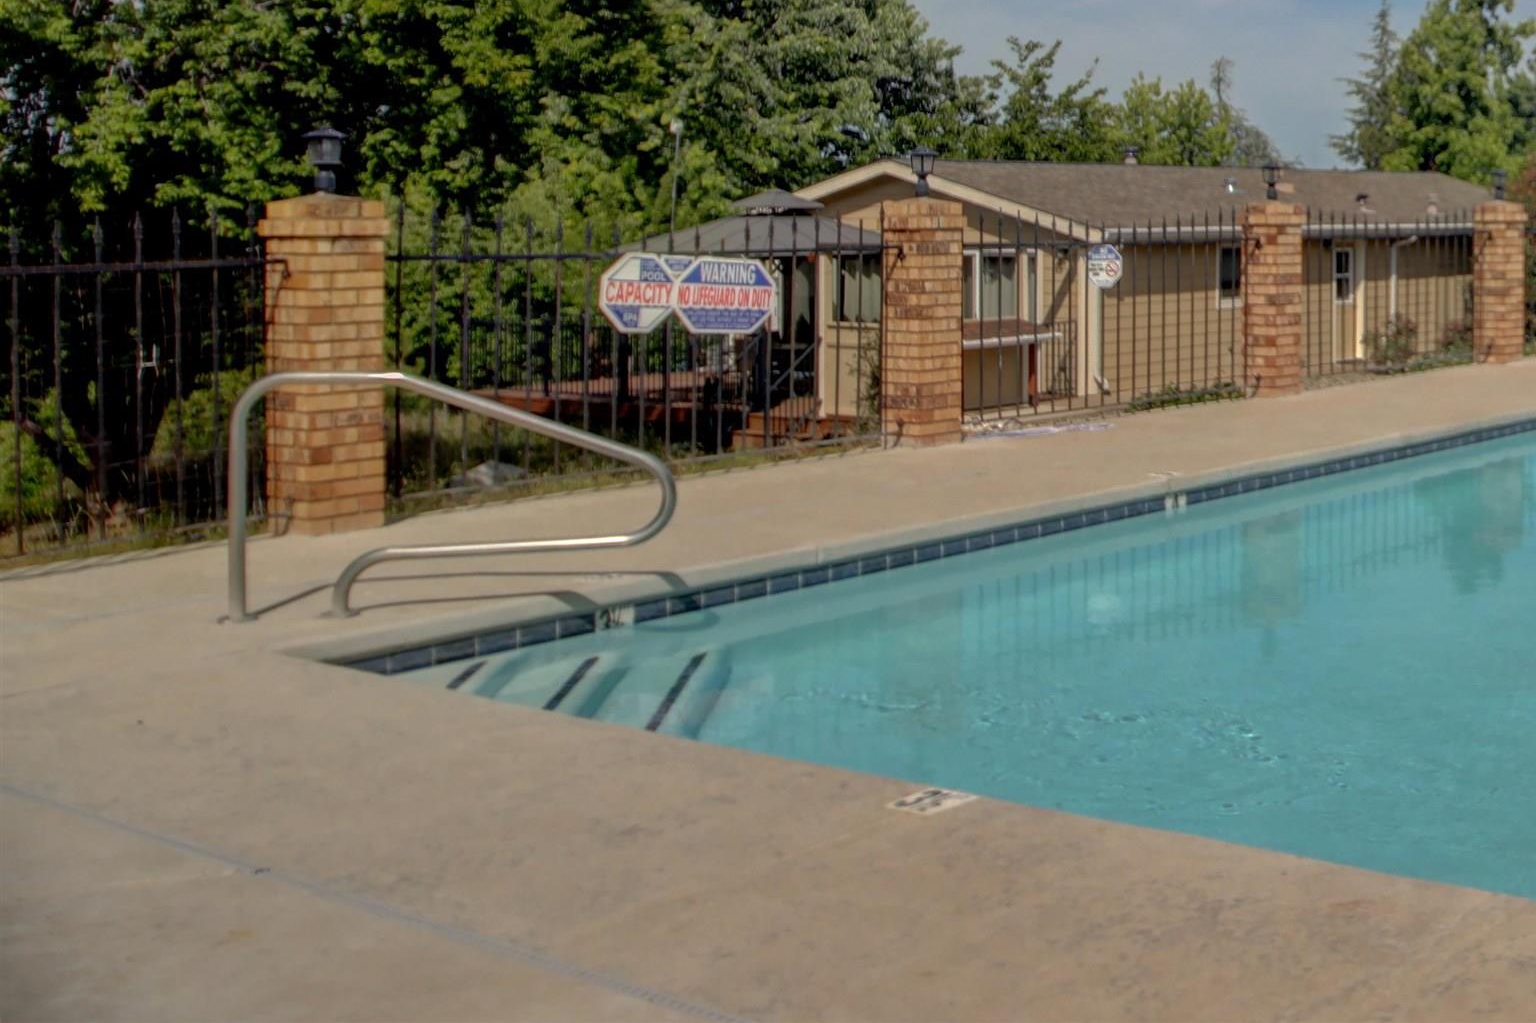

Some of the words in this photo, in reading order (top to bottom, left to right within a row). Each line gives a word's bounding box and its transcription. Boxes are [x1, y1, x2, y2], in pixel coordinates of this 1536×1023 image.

[641, 271, 667, 281] POOL
[700, 262, 756, 284] WARNING
[606, 282, 673, 304] CAPACITY
[678, 285, 690, 306] NO
[692, 286, 736, 307] LIFEGUARD
[738, 288, 750, 308] ON
[751, 289, 772, 308] DUTY
